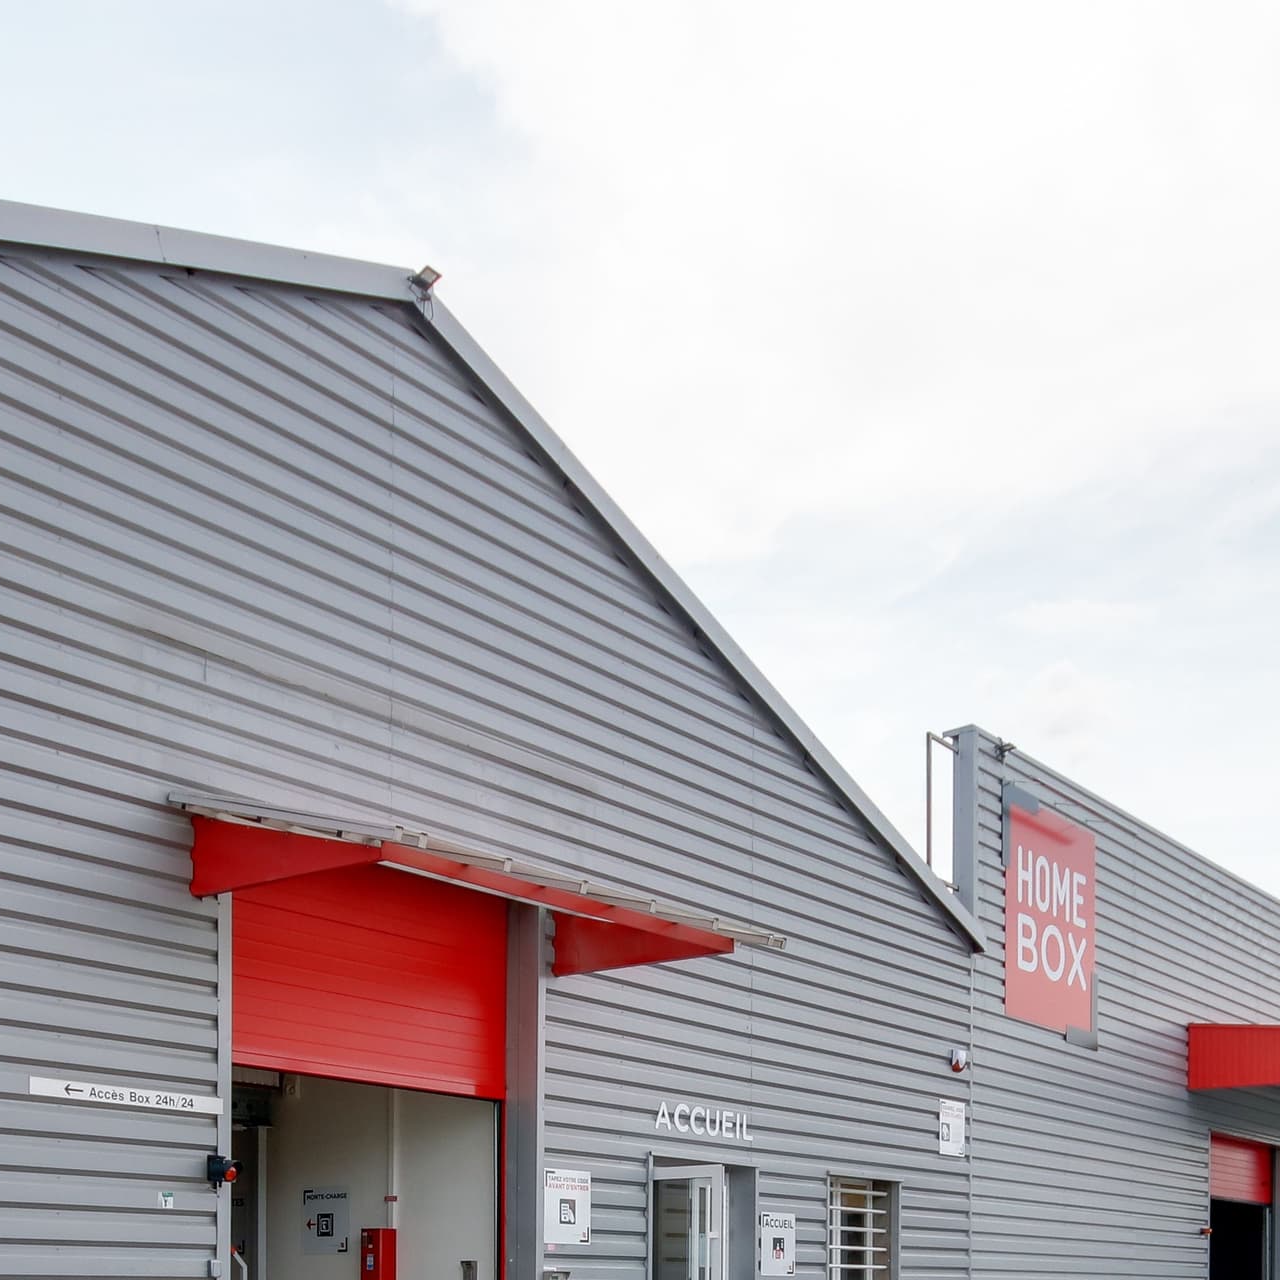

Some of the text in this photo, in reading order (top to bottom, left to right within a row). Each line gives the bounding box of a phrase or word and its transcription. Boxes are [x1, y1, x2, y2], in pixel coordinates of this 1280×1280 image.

[1017, 845, 1087, 929] HOME
[1017, 912, 1087, 991] BOX
[89, 1087, 194, 1109] Accès Box 24h/24
[655, 1101, 754, 1141] ACCUEIL
[306, 1192, 347, 1200] MONTE-CHARGE
[765, 1218, 794, 1230] ACCUEIL
